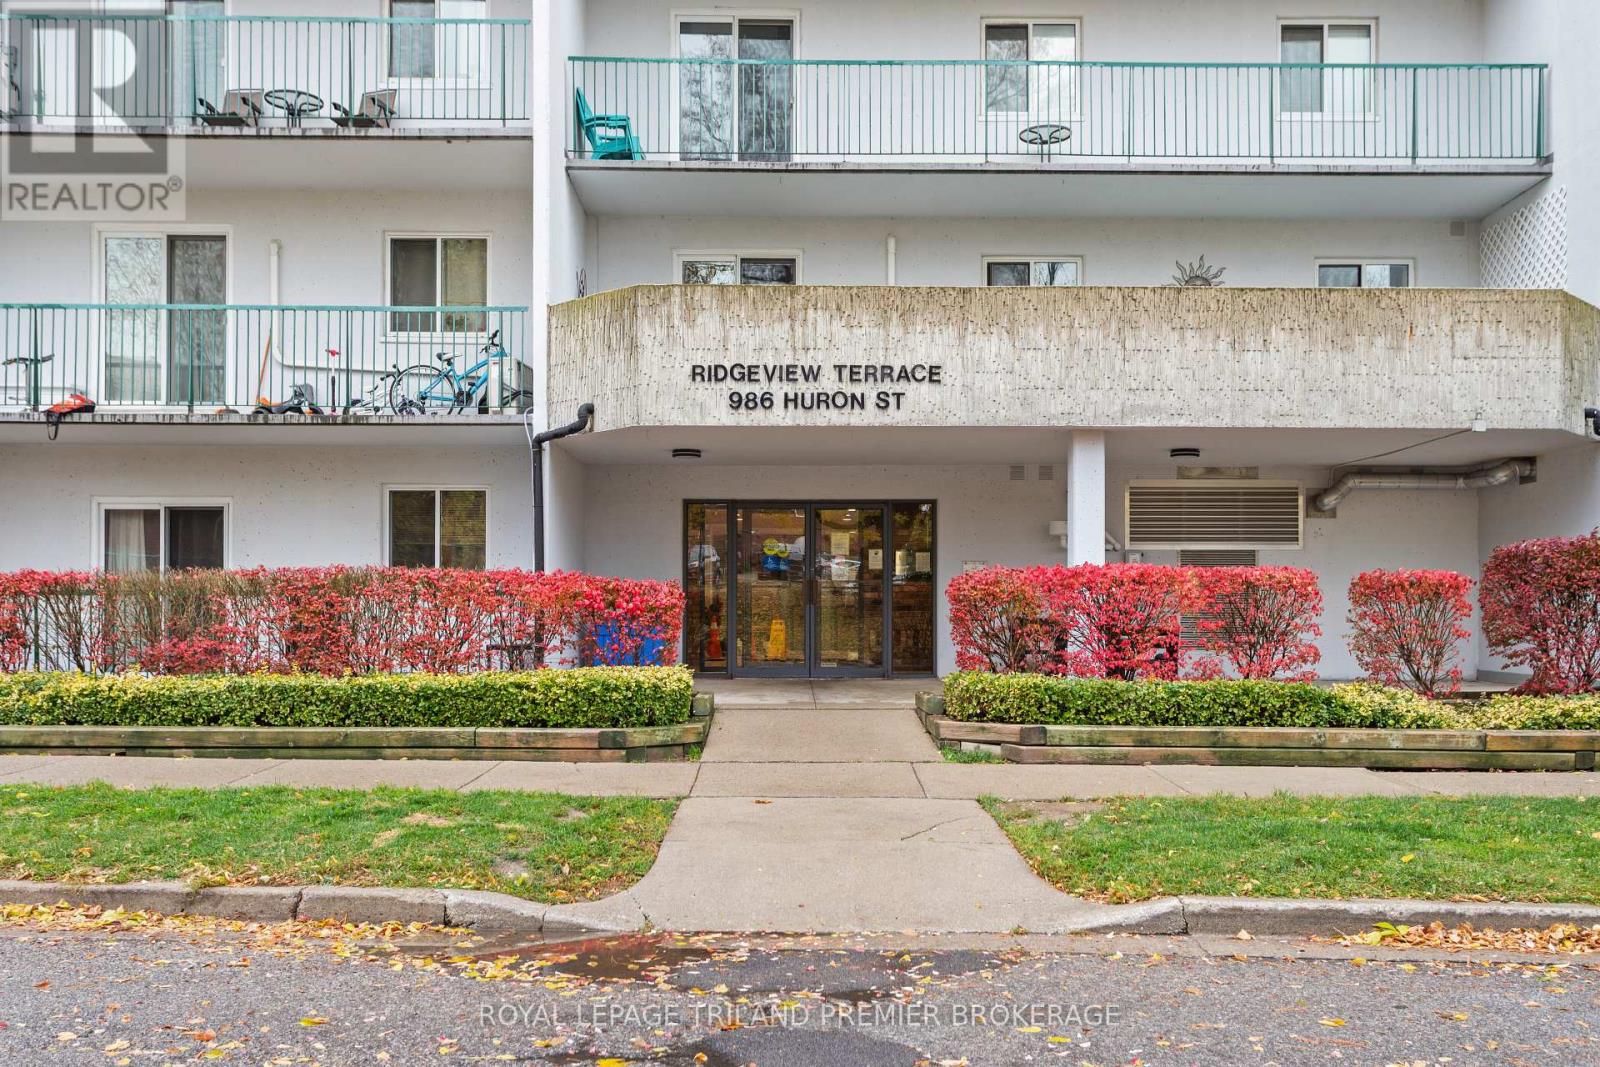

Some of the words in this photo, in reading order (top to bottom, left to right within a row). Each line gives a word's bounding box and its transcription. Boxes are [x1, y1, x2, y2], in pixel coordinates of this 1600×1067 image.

[691, 363, 822, 384] RIDGEVIEW
[833, 363, 942, 384] TERRACE
[728, 391, 774, 411] 986
[784, 391, 865, 411] HURON
[875, 391, 906, 411] ST
